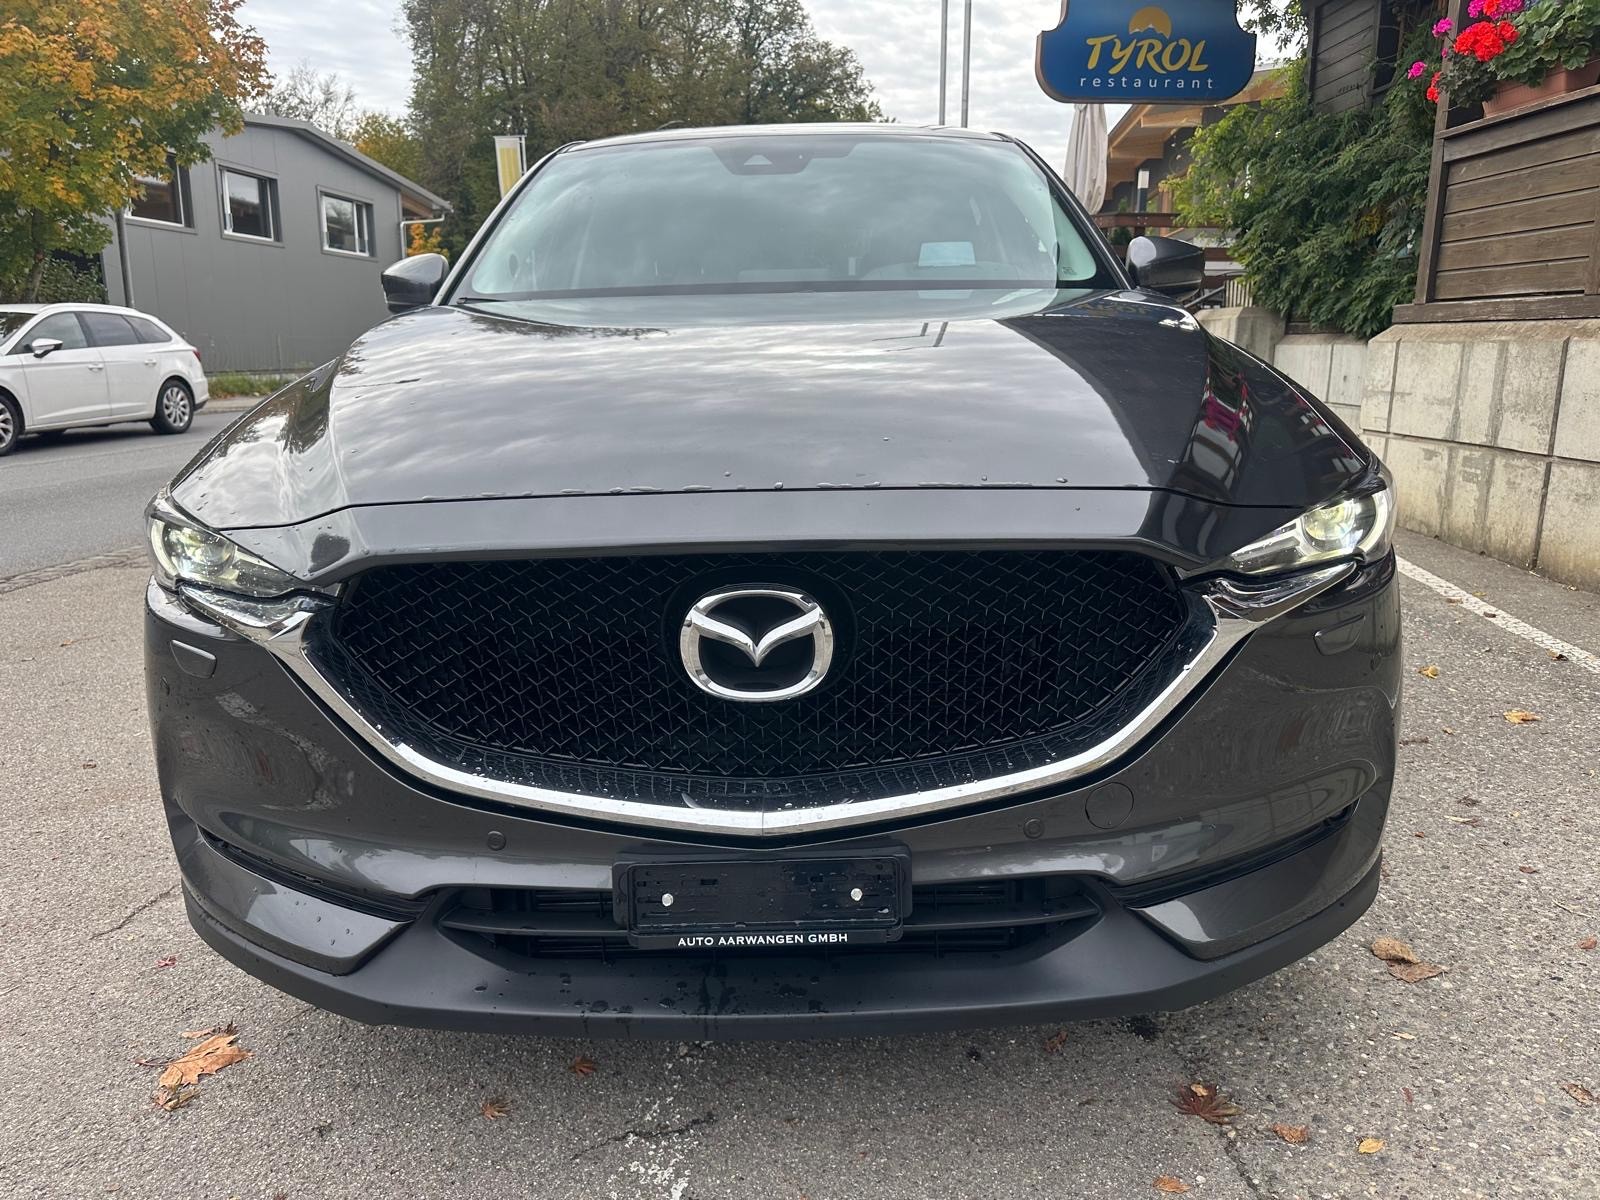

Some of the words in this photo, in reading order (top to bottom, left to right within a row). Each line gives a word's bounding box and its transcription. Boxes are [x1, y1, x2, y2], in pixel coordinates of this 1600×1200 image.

[1086, 34, 1209, 75] TYROL
[1080, 76, 1213, 89] restaurant
[678, 936, 714, 947] AUTO
[718, 934, 804, 946] AARWANGEN
[808, 933, 848, 943] GMBH
